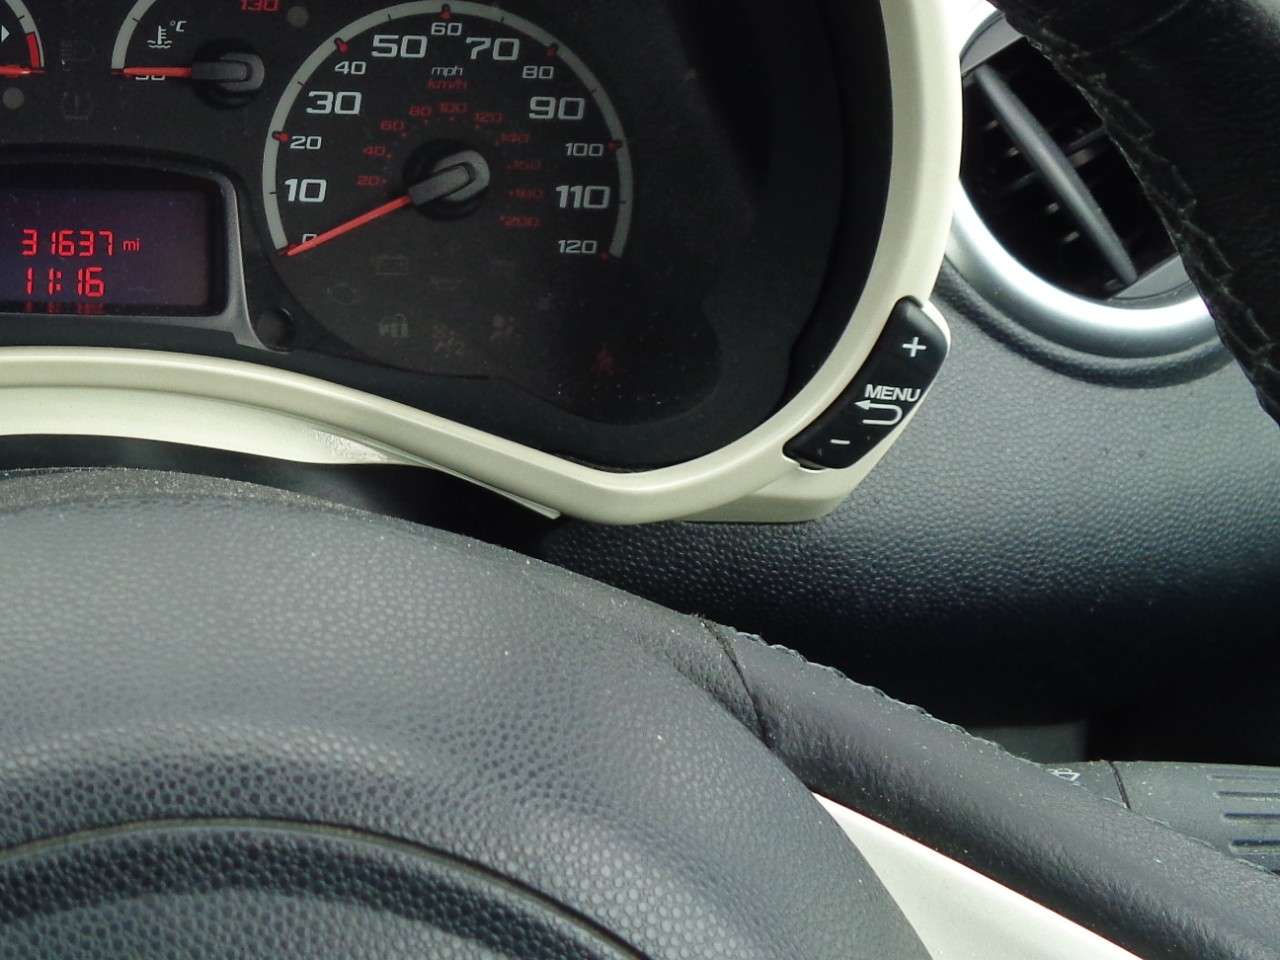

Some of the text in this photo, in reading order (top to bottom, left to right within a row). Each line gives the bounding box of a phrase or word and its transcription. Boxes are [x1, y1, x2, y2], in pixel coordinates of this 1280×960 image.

[430, 21, 463, 36] 60
[371, 34, 429, 59] 50
[465, 37, 520, 61] 70
[334, 61, 366, 76] 40
[431, 65, 463, 78] mph
[522, 65, 555, 80] 80
[306, 91, 362, 116] 30
[529, 96, 585, 121] 90
[289, 136, 322, 150] 20
[565, 143, 604, 157] 100
[284, 178, 327, 203] 10
[555, 185, 611, 210] 110
[22, 229, 140, 257] 31637 mi
[557, 240, 597, 254] 120
[25, 267, 105, 298] 11:16
[865, 384, 921, 402] MENU
